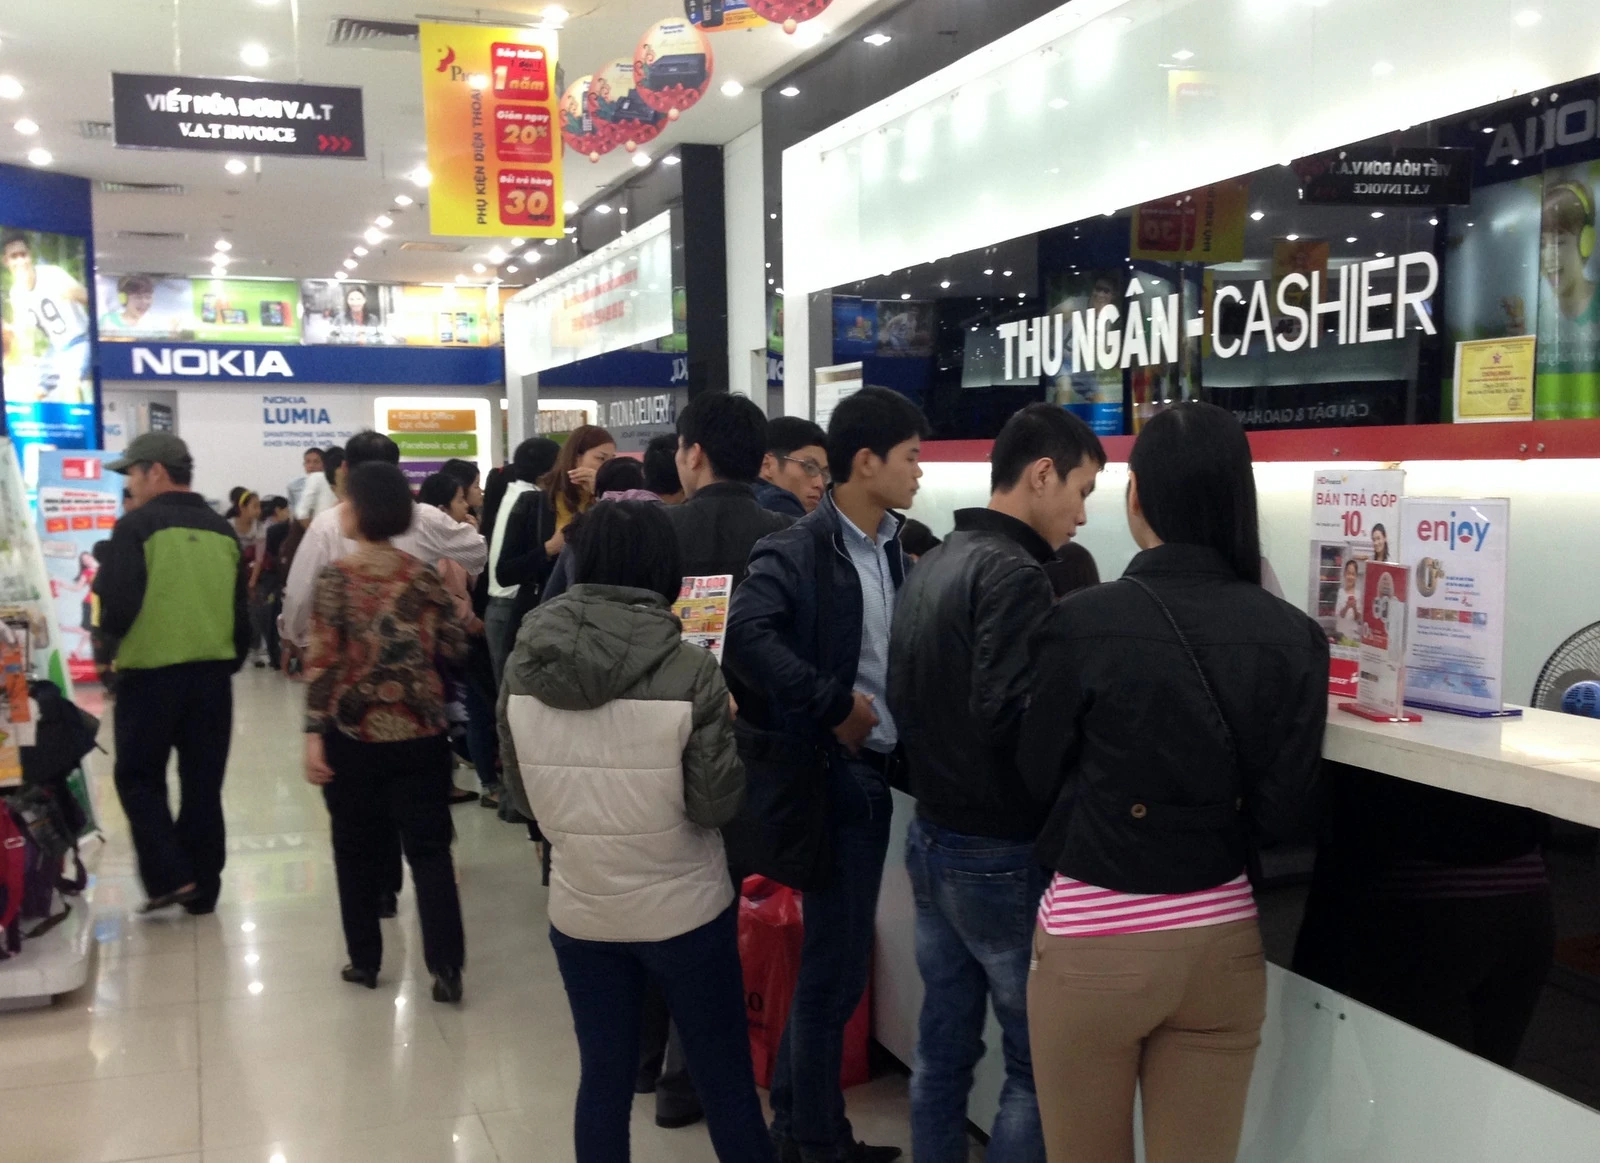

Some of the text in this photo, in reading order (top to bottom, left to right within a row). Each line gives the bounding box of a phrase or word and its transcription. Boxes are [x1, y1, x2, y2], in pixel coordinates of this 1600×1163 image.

[495, 66, 545, 90] 1 năm
[223, 124, 297, 142] INVOICE
[502, 124, 547, 144] 20%
[472, 132, 486, 162] ĐIỆN
[474, 166, 487, 195] KIỆN
[476, 199, 488, 225] PHỤ
[504, 190, 549, 215] 30
[998, 313, 1064, 381] THU
[1072, 277, 1179, 374] NGÂN
[1212, 251, 1439, 359] CASHIER
[131, 348, 294, 378] NOKIA
[263, 408, 331, 424] LUMIA
[1417, 511, 1490, 551] enjoy
